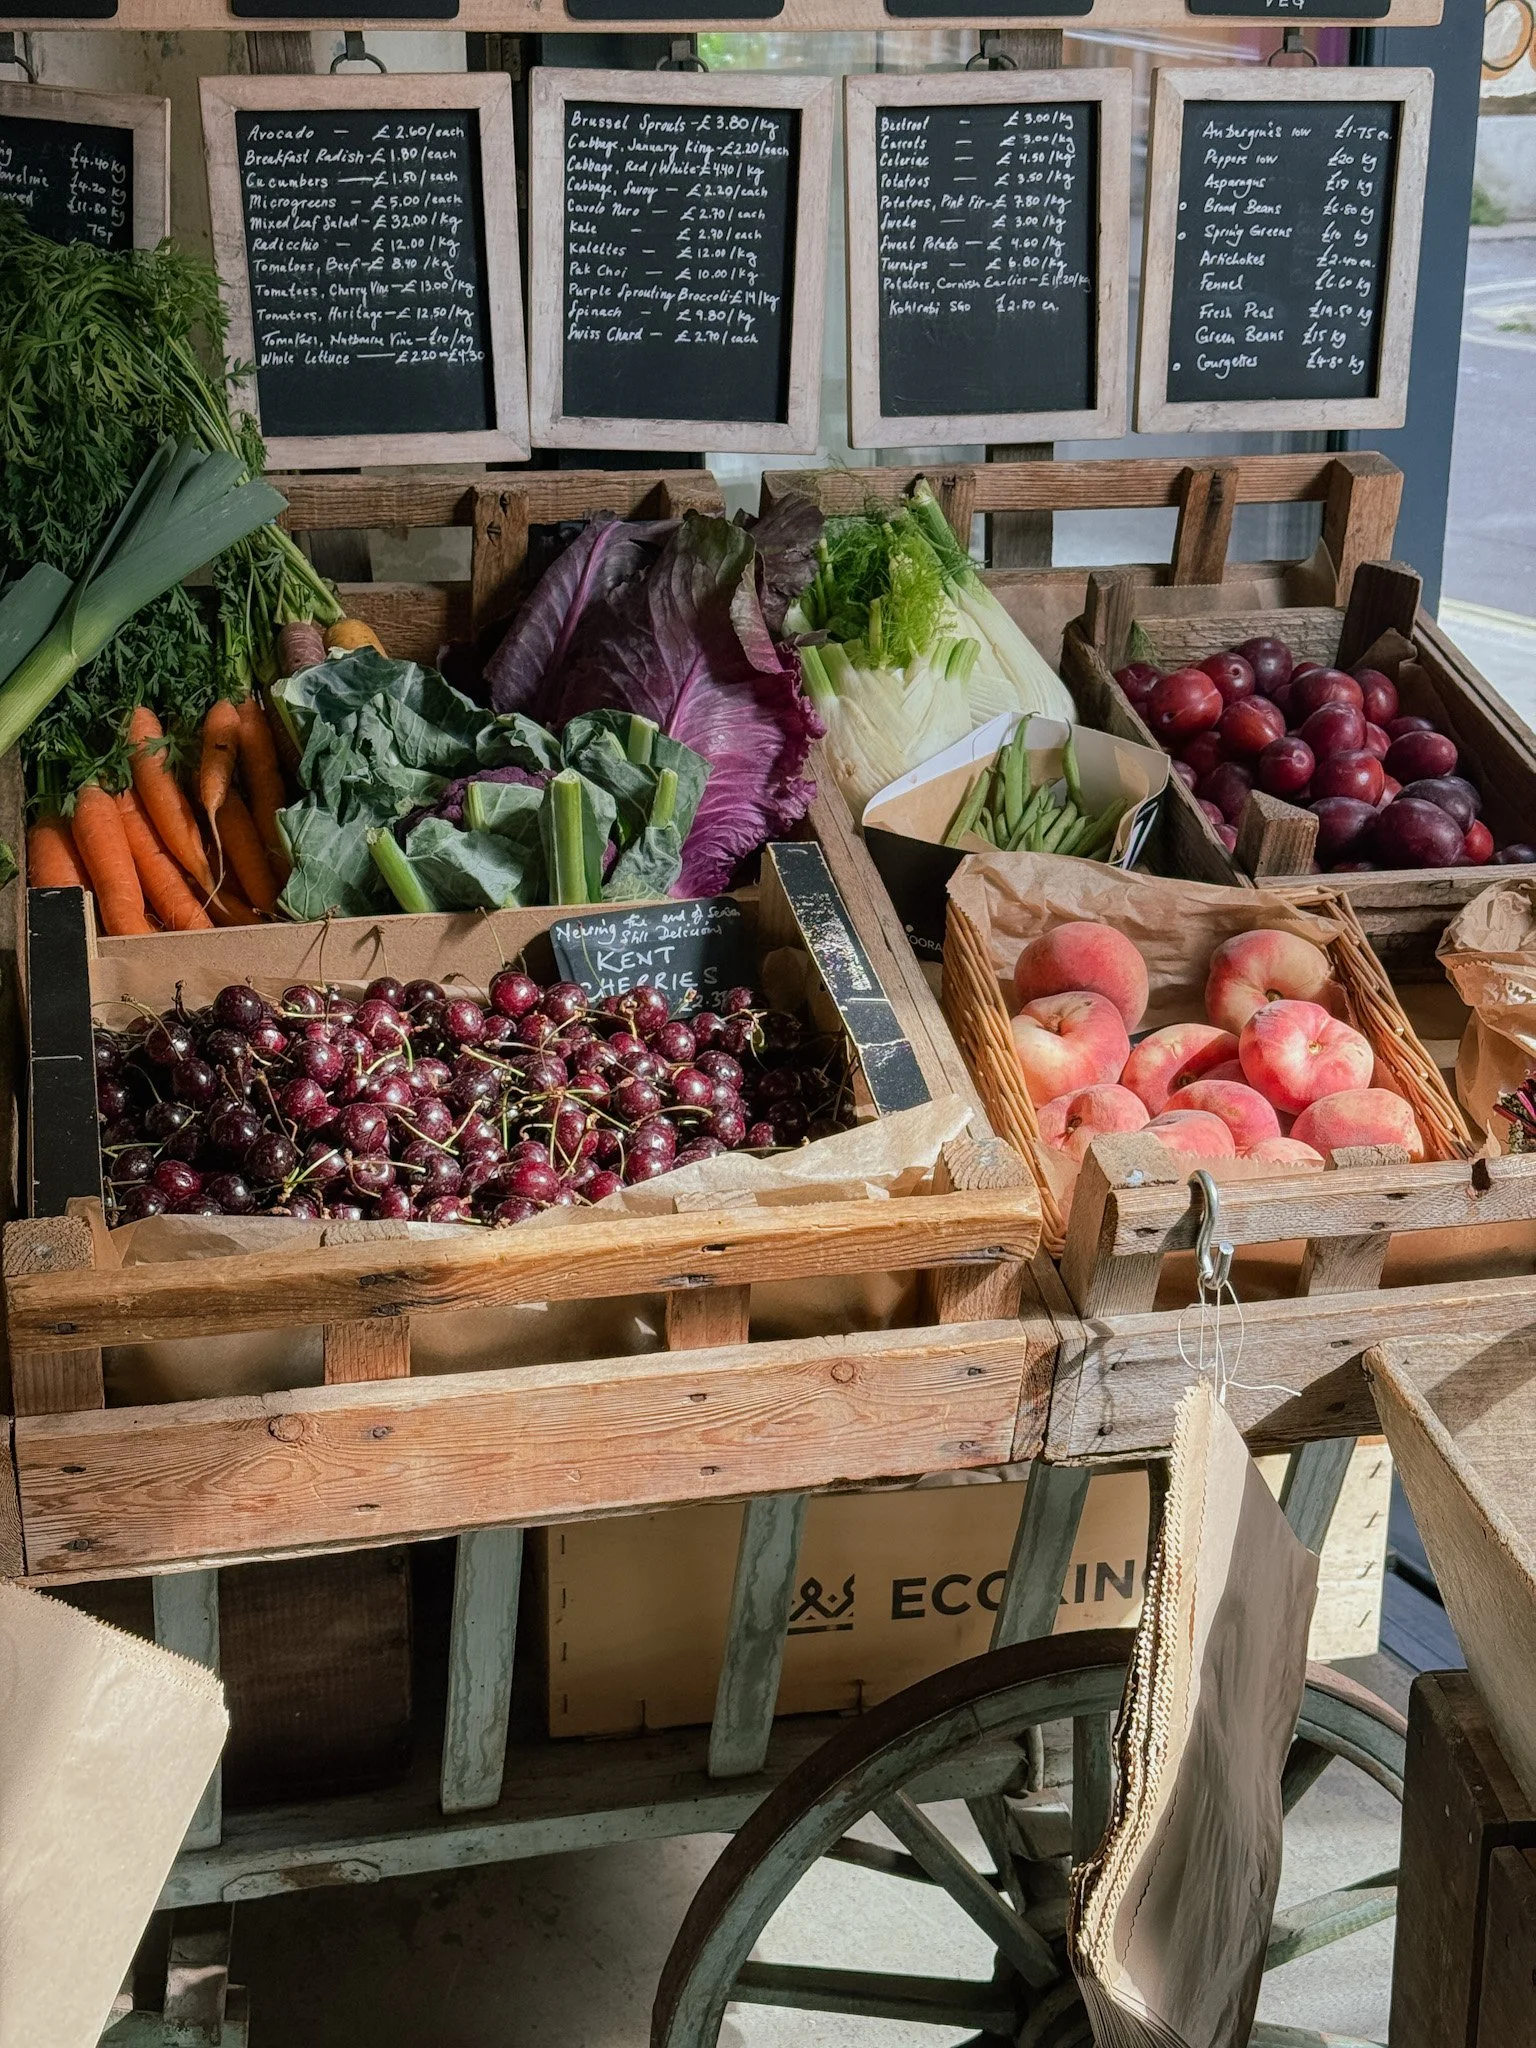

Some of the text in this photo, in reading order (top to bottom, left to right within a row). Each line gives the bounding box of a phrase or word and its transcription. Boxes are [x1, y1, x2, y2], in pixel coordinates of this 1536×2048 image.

[247, 124, 315, 141] Avocado
[571, 110, 630, 130] Brussel
[639, 113, 687, 138] Sprouts
[881, 116, 930, 133] Beetroot
[1334, 114, 1377, 139] £1.75
[567, 133, 625, 159] Cabbage,
[627, 137, 680, 164] January
[684, 139, 715, 163] King
[880, 135, 927, 150] Carrots
[244, 148, 310, 167] Breakfast
[315, 148, 365, 164] Radish
[566, 155, 620, 180] Cabbage,
[879, 151, 930, 168] Celeriac
[1203, 148, 1248, 169] Peppers
[1327, 146, 1355, 167] £20
[1361, 152, 1378, 173] kg
[245, 171, 329, 189] Cucumbers
[566, 175, 618, 200] Cabbage,
[622, 180, 659, 204] Savoy
[881, 172, 931, 190] Potatoes
[1204, 173, 1267, 199] Asparagus
[1356, 179, 1374, 197] kg
[249, 194, 337, 218] Microgreens
[567, 198, 606, 215] Cavolo
[612, 202, 641, 217] Nero
[880, 194, 937, 213] Potatoes,
[940, 193, 965, 208] Pink
[967, 195, 986, 209] Fir
[1203, 195, 1375, 226] Broad Beans £6.80 kg
[250, 215, 290, 231] Mixed
[293, 215, 321, 231] Leaf
[322, 213, 359, 231] Salad
[569, 220, 598, 235] Kale
[880, 212, 917, 231] Swede
[86, 223, 114, 244] 75p
[252, 236, 319, 252] Radicchio
[880, 234, 917, 253] Sweet
[922, 235, 959, 252] Potato
[1203, 220, 1369, 248] Spring Greens £10 kg
[569, 241, 627, 257] Kalettes
[1199, 249, 1266, 267] Artichokes
[1316, 243, 1358, 268] £2.40
[253, 256, 321, 279] Tomatoes,
[325, 256, 361, 279] Beef
[569, 261, 591, 276] Pak
[596, 264, 628, 278] Choi
[881, 257, 928, 278] Turnips
[255, 282, 325, 299] Tomatoes,
[329, 283, 368, 309] Cherry
[370, 280, 389, 297] Vine
[883, 276, 936, 294] Potatoes,
[936, 277, 981, 290] Cornish
[983, 275, 1027, 289] Earlies
[1199, 268, 1372, 298] Fennel £6.60 kg
[568, 282, 612, 300] Purple
[617, 282, 676, 312] Sprouting
[677, 287, 729, 302] Broccoli
[888, 299, 940, 317] Kohlrabi
[996, 293, 1036, 313] £2.80
[257, 308, 323, 322] Tomatoes,
[328, 304, 382, 331] Heritage
[568, 299, 622, 323] Spinach
[1199, 298, 1374, 327] Fresh Peas £19.50 kg
[390, 331, 414, 347] Vine
[567, 322, 601, 341] Swiss
[606, 326, 644, 342] Chard
[1195, 321, 1347, 349] Green Beans £15 kg
[261, 351, 294, 367] Whole
[304, 349, 350, 365] Lettuce
[1196, 346, 1365, 380] Courgettes £4.80 kg
[622, 913, 648, 929] the
[661, 909, 686, 923] end
[691, 904, 704, 925] of
[619, 921, 722, 944] Still Delicious
[596, 945, 675, 973] KENT
